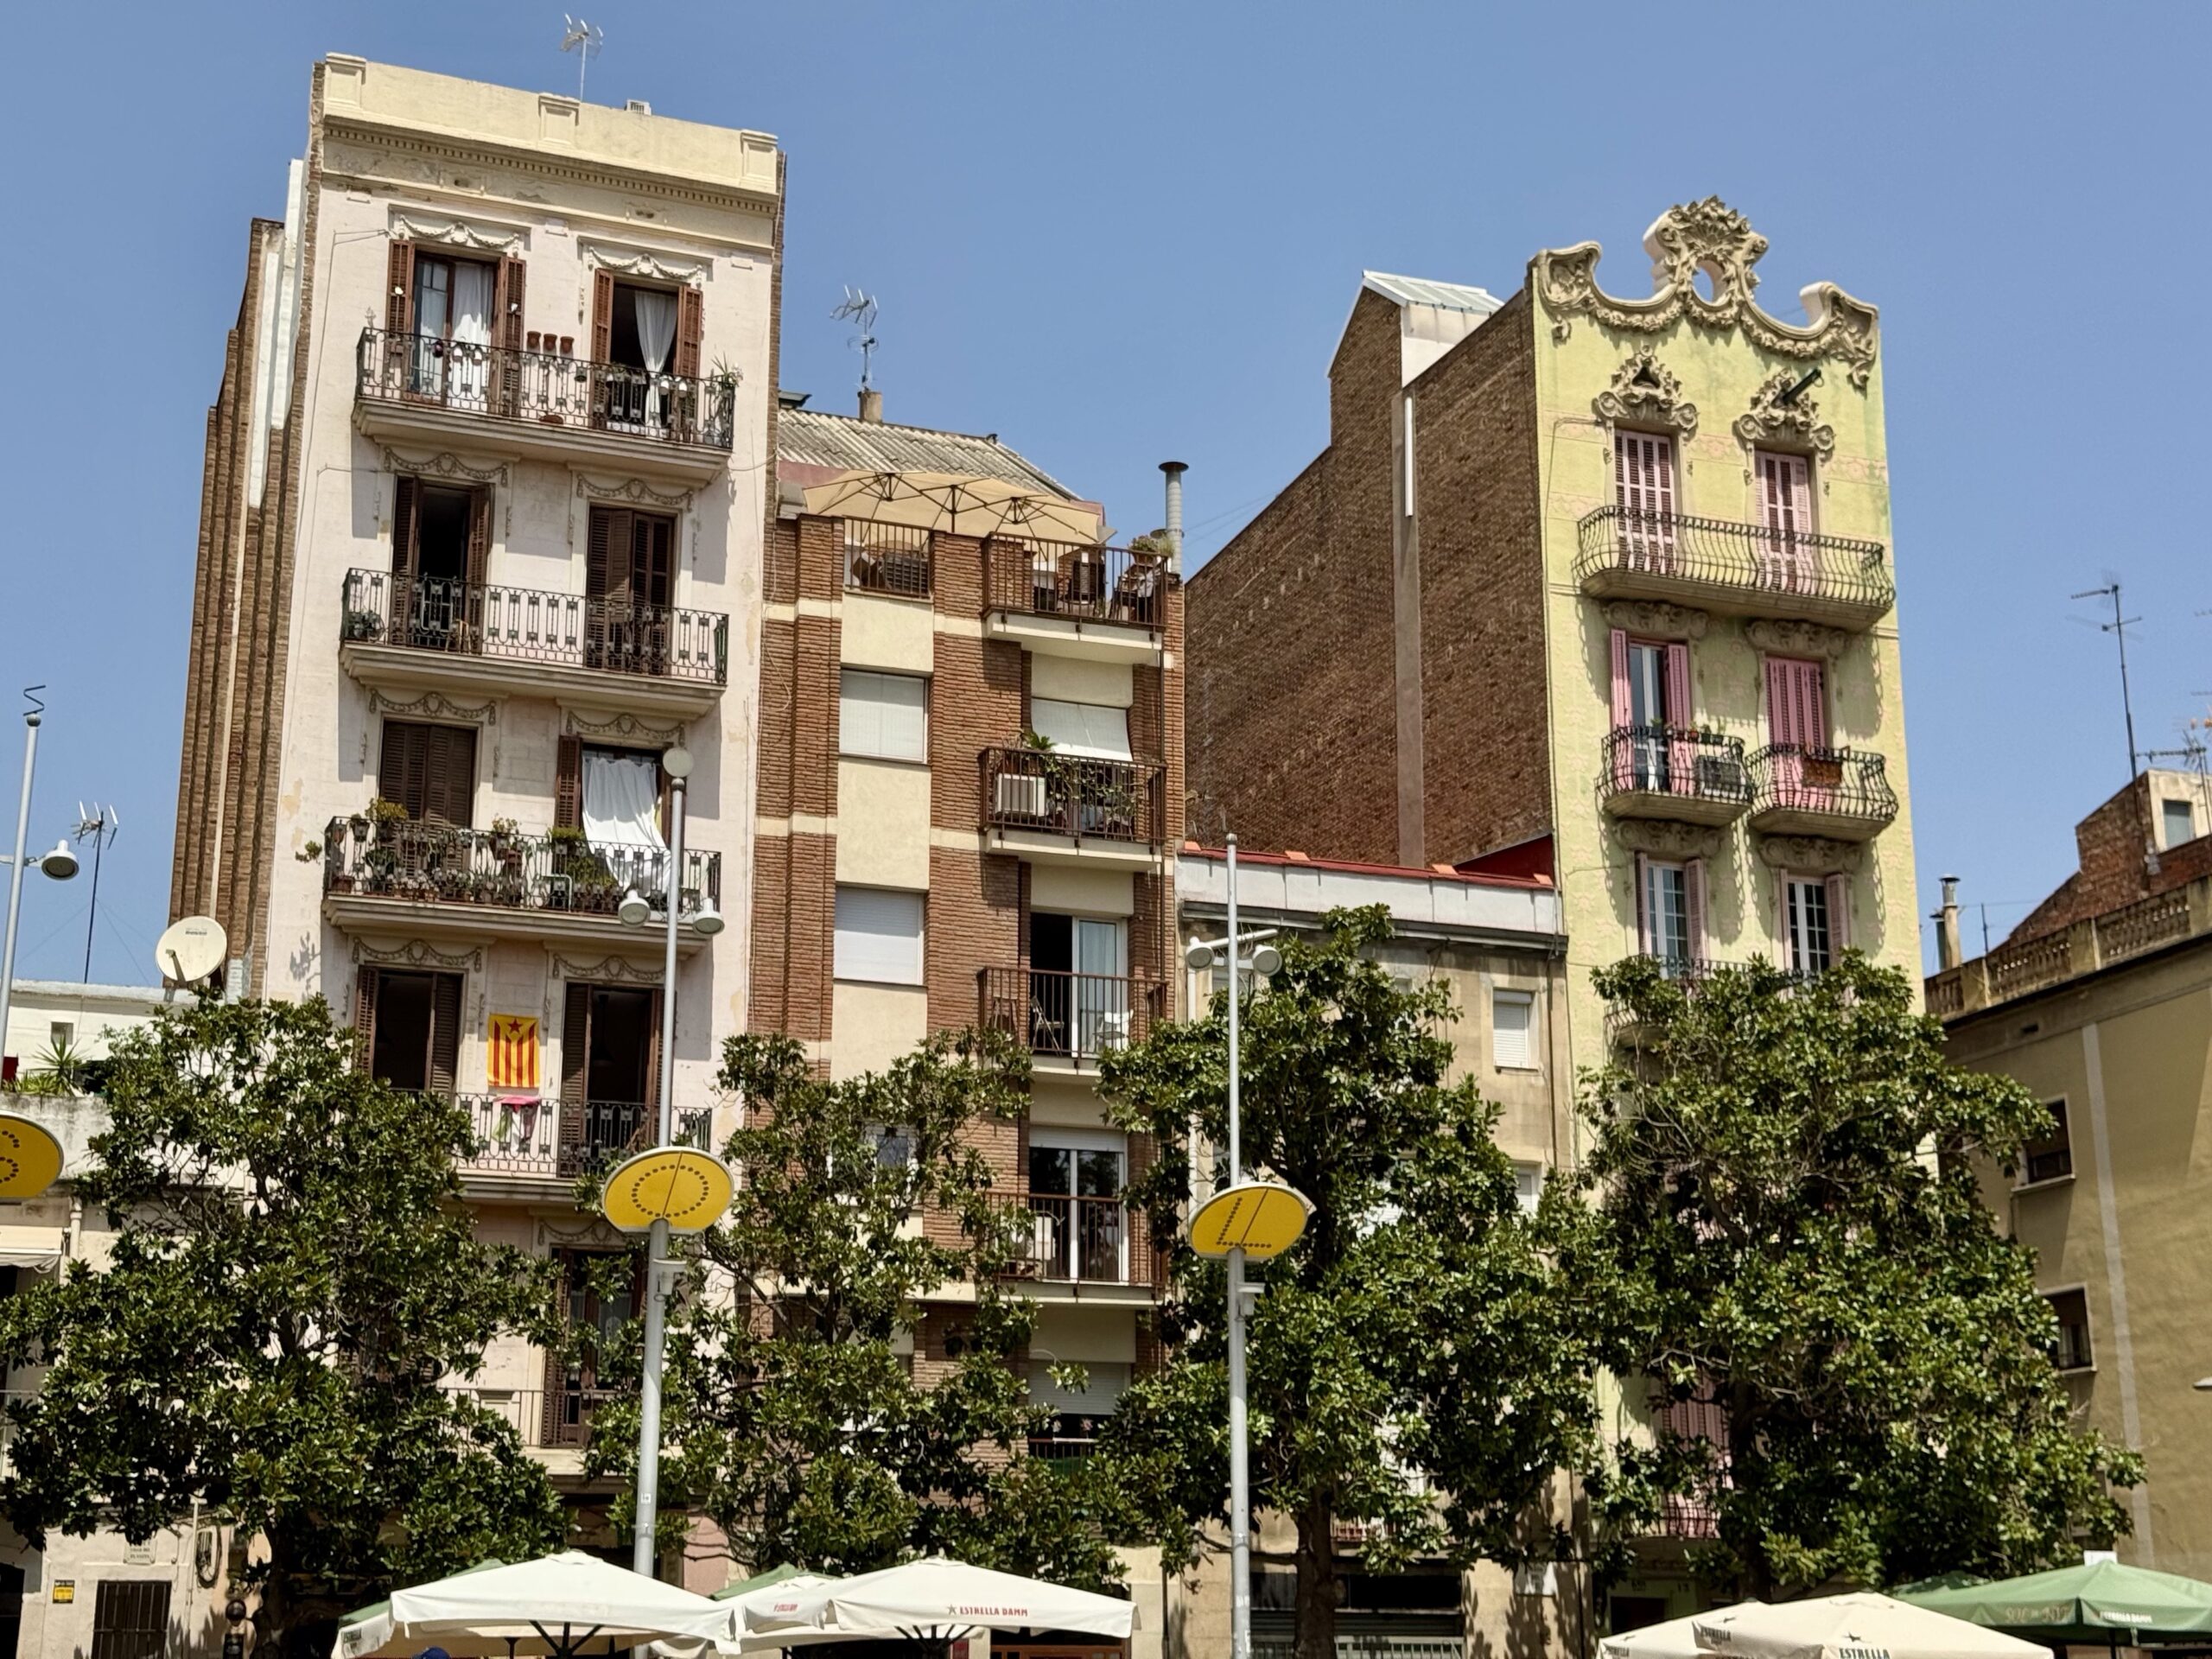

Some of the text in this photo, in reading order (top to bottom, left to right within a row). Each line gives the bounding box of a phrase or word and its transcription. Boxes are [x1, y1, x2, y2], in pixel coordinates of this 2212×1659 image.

[959, 1605, 1028, 1617] ESTRELLA DAMM
[1839, 1646, 1891, 1659] ESTRELLA
